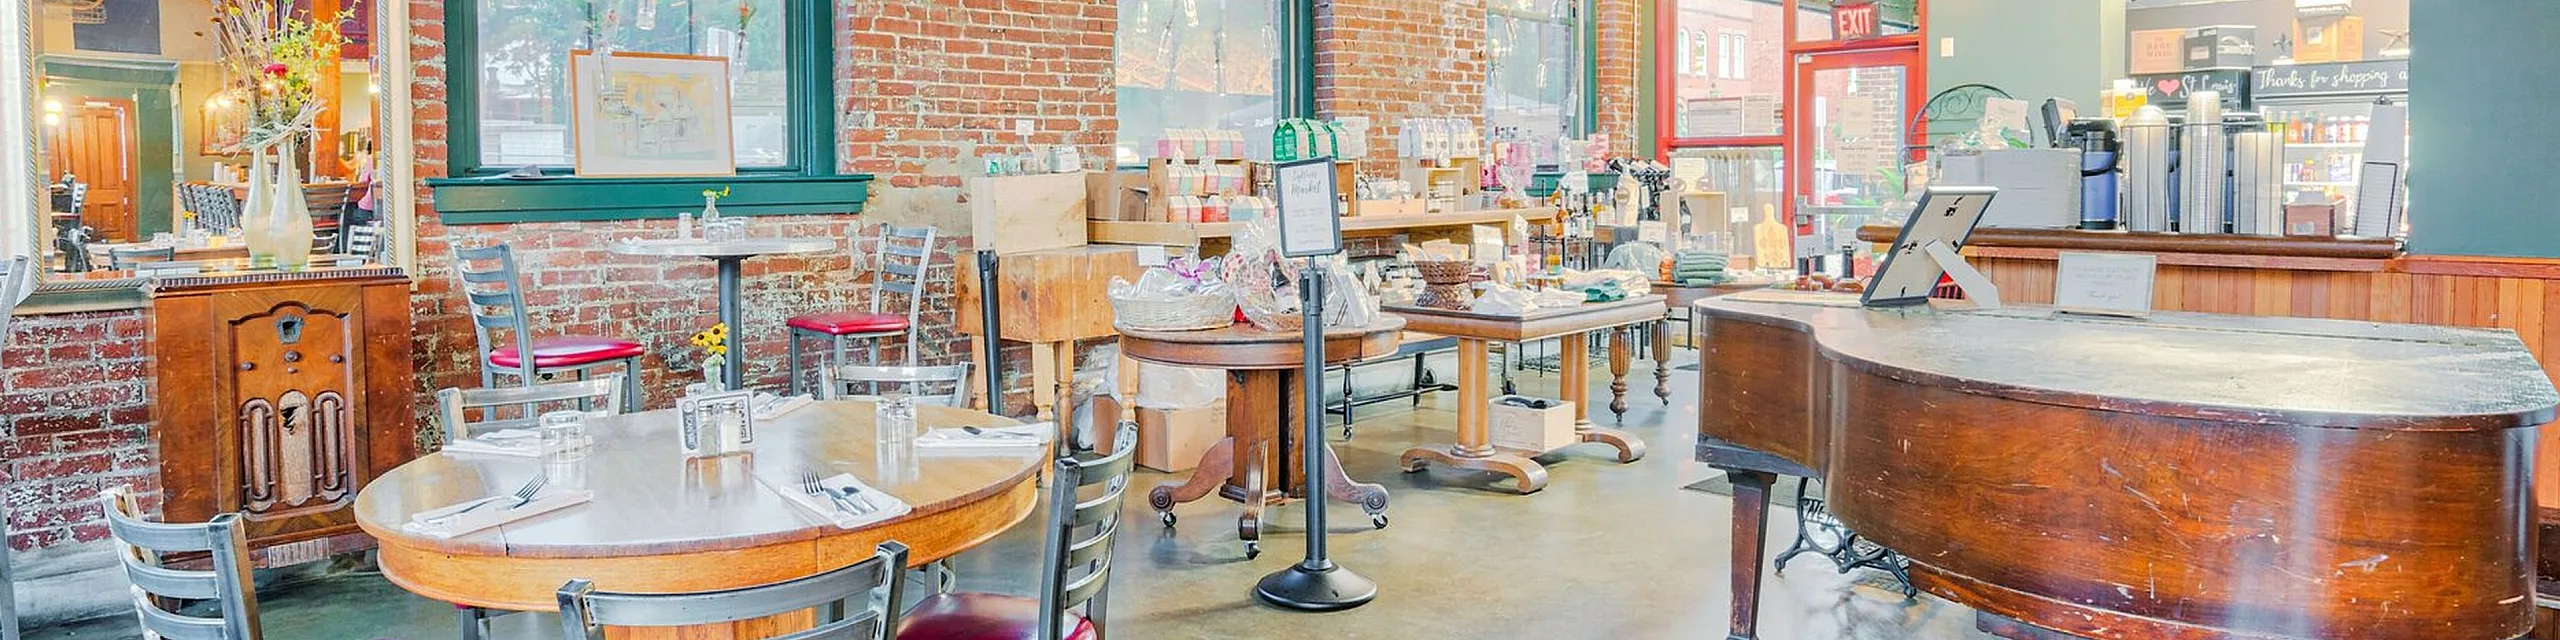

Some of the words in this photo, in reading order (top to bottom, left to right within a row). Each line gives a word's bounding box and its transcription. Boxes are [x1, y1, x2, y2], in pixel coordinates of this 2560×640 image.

[1838, 7, 1871, 36] EXIT
[2257, 67, 2305, 90] Thanks
[2310, 69, 2328, 88] for
[2332, 64, 2388, 88] shopping
